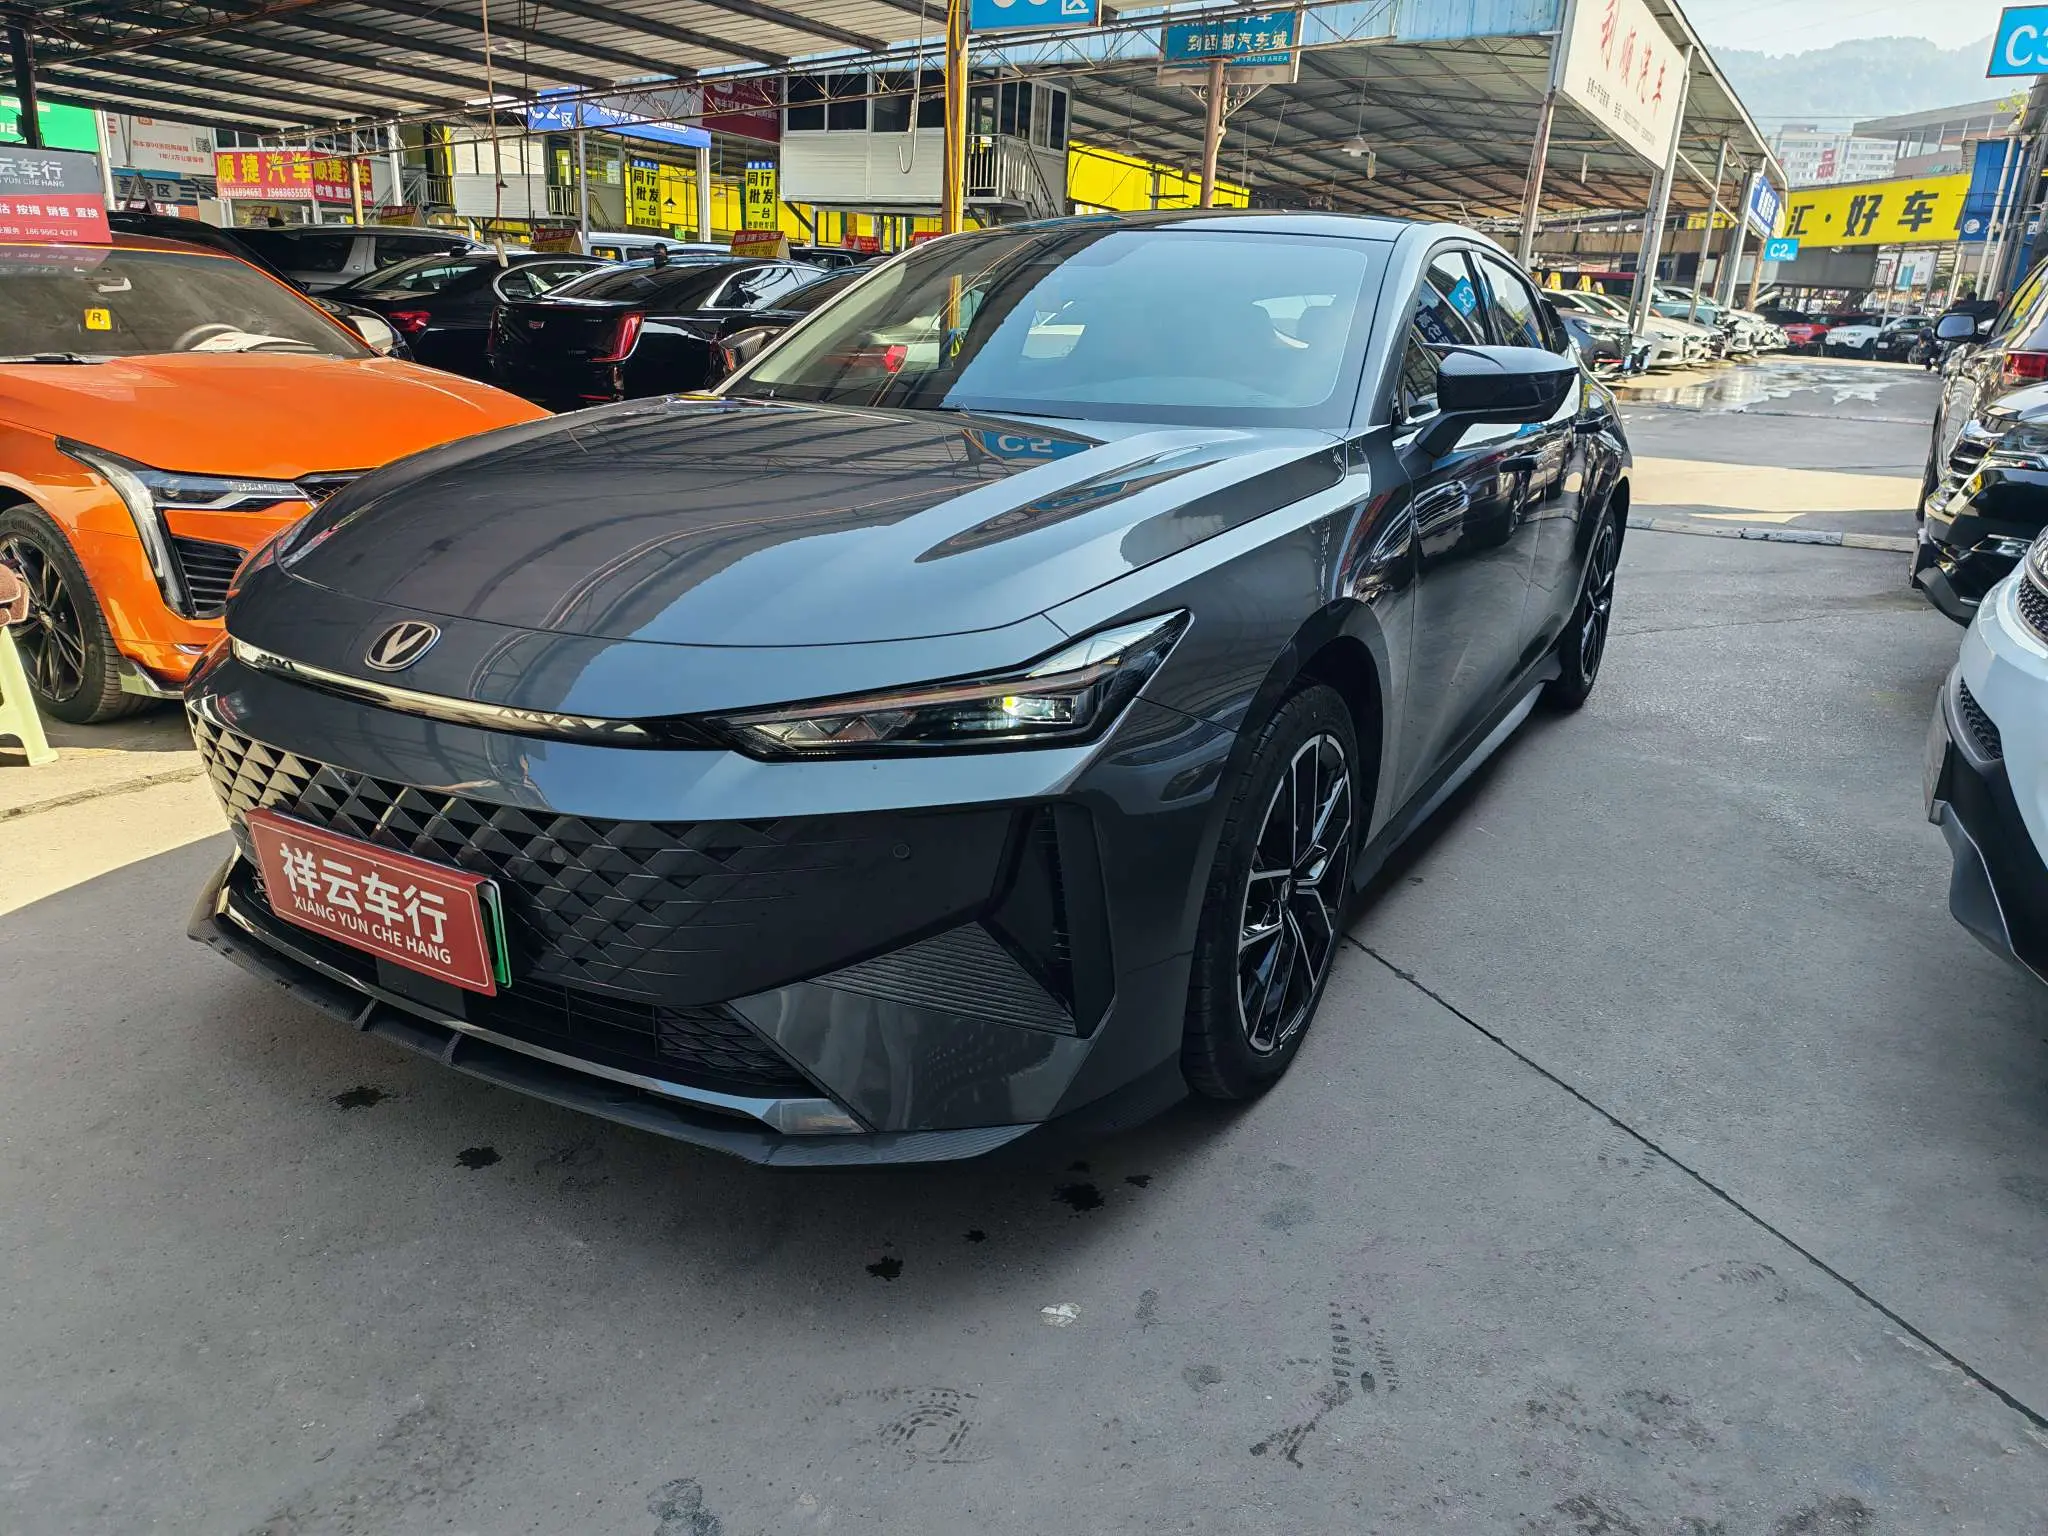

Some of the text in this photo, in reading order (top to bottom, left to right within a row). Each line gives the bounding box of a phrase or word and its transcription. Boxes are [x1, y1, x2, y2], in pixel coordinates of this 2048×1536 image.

[217, 154, 312, 184] 顺捷汽车
[633, 169, 656, 185] 同行
[747, 171, 771, 186] 同行
[637, 185, 659, 202] 批发
[749, 188, 773, 204] 批发
[1786, 190, 1966, 238] 汇·好车
[1770, 243, 1789, 257] C2
[280, 842, 448, 944] 祥云车行
[293, 893, 453, 966] XIANG YUN CHE HANG
